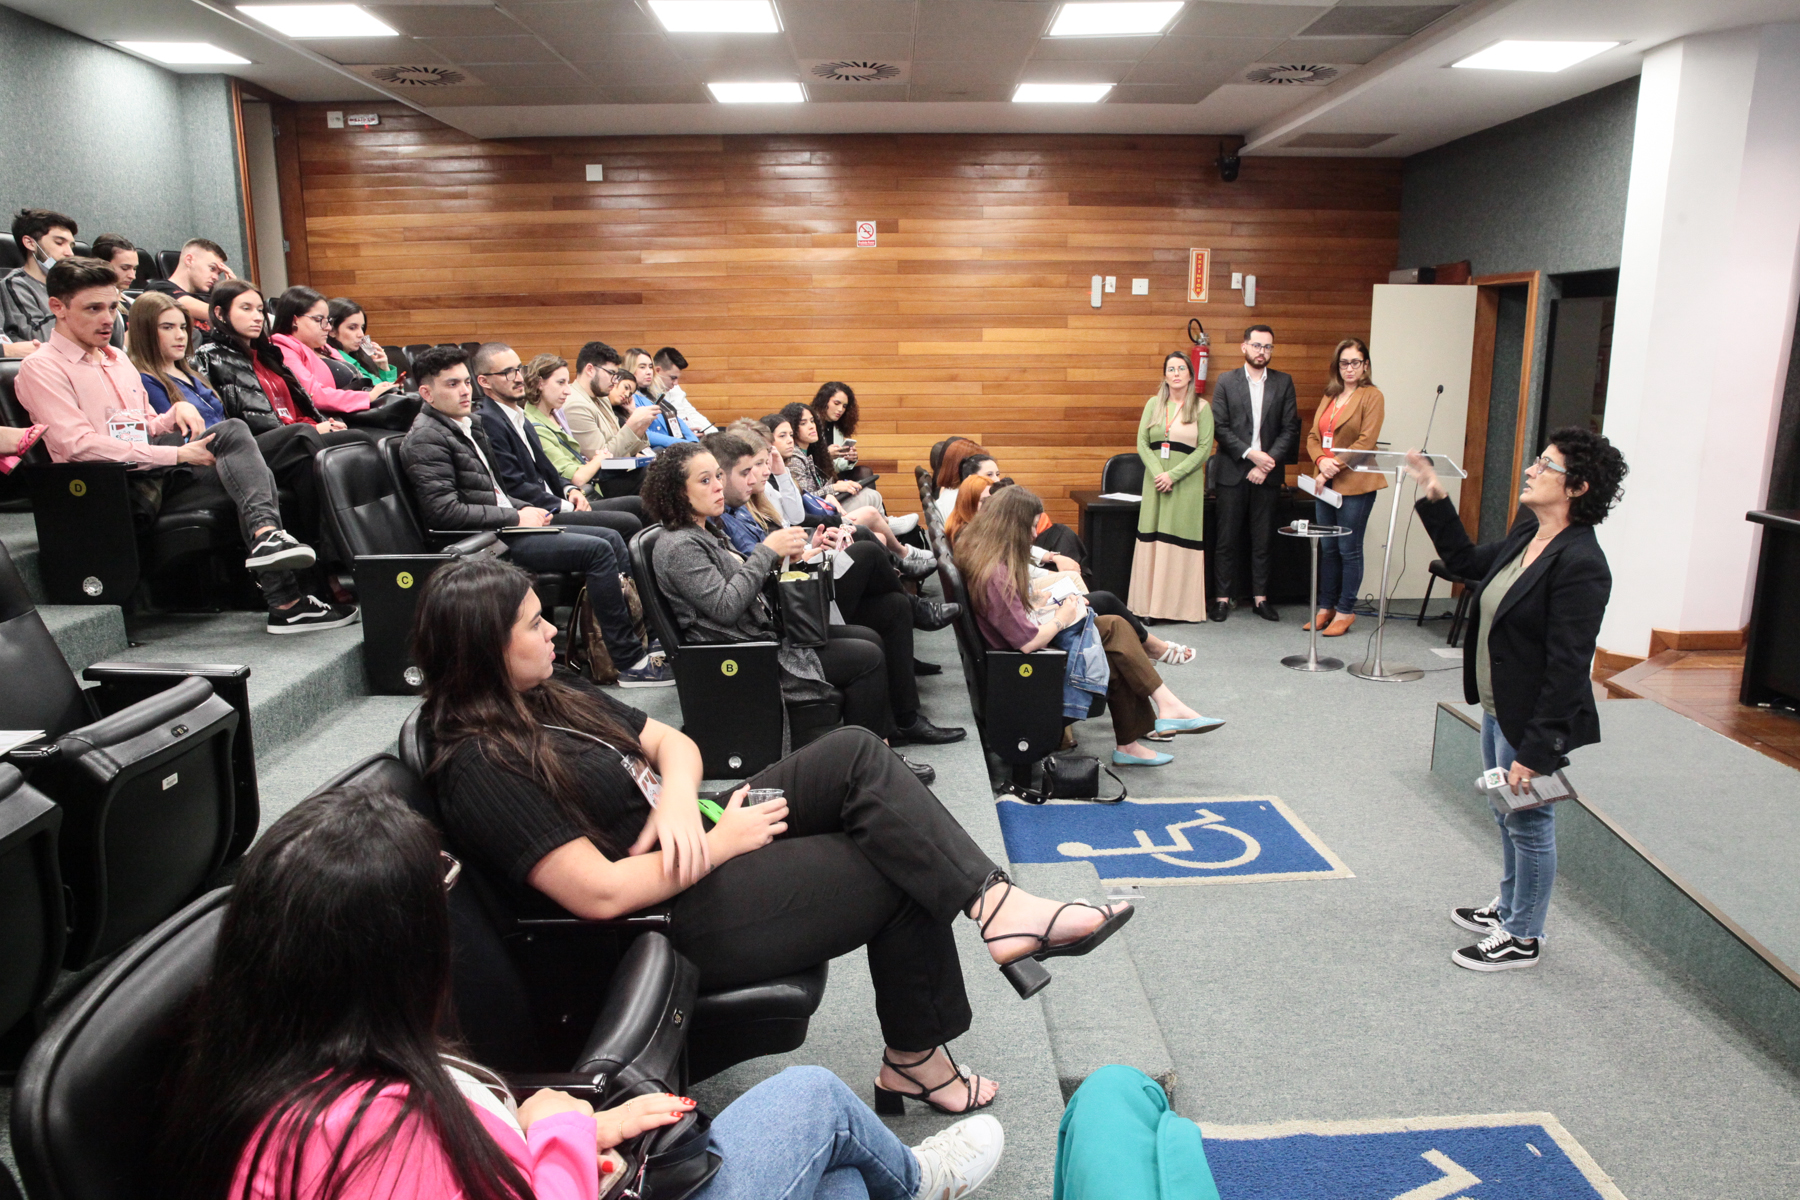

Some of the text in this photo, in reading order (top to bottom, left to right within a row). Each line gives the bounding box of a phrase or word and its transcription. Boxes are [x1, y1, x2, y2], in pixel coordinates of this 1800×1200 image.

[74, 483, 83, 493] D
[401, 575, 409, 585] C
[726, 664, 734, 673] B
[1023, 666, 1030, 674] A
